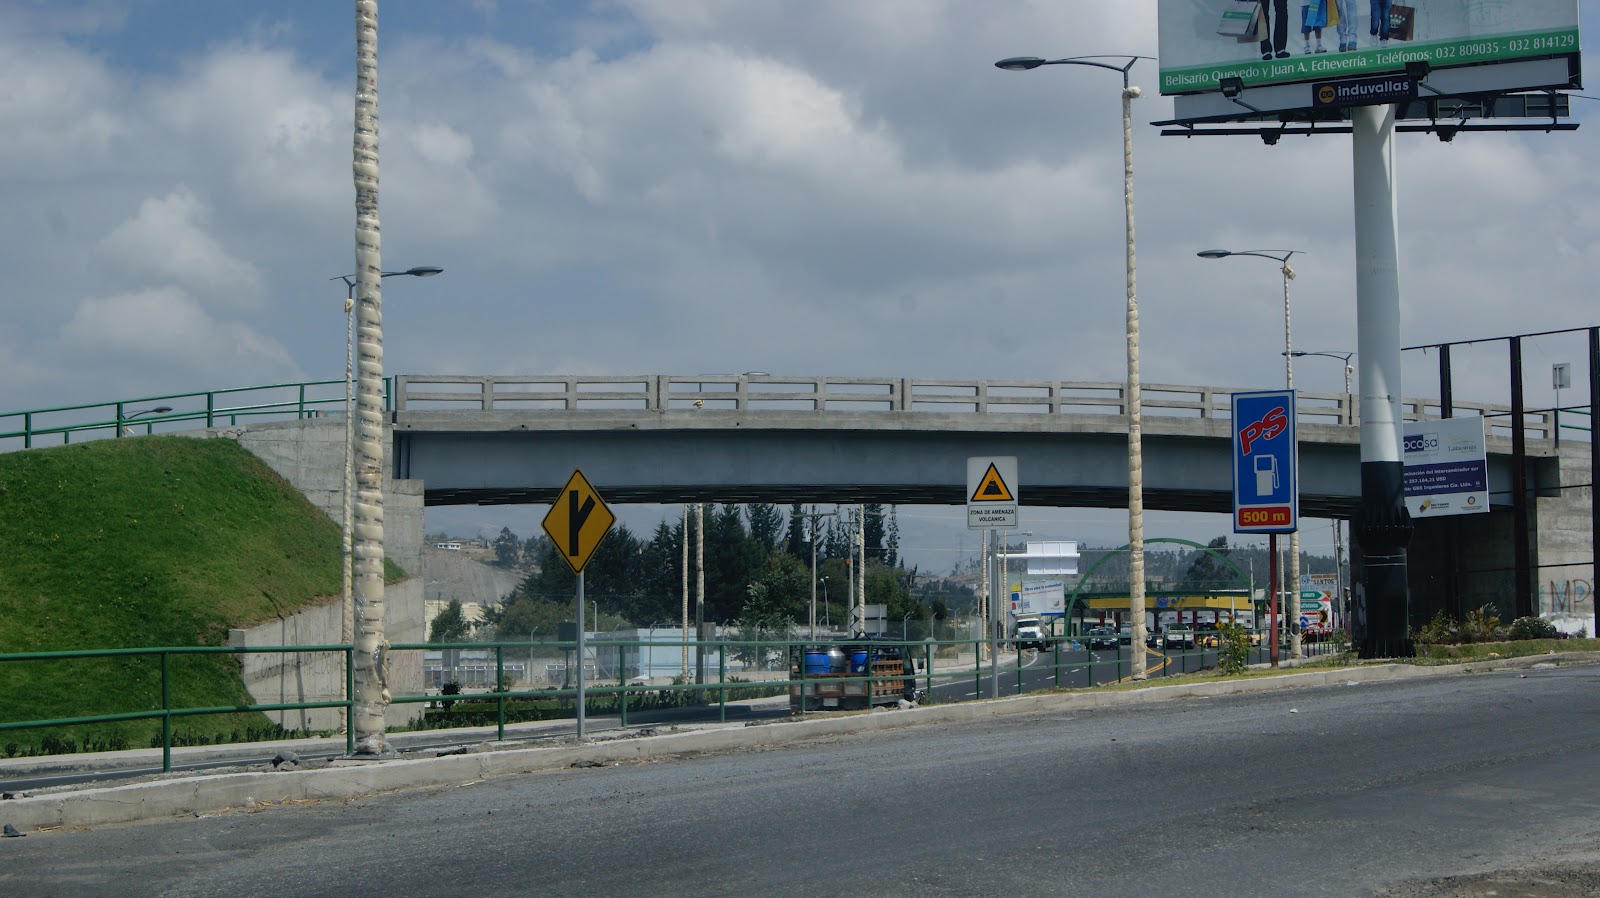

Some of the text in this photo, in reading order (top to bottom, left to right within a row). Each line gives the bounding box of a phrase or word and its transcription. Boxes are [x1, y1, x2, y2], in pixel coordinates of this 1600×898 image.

[1165, 71, 1209, 86] Belisario
[1212, 67, 1259, 82] Quevedo
[1262, 68, 1268, 78] y
[1270, 64, 1294, 77] Juan
[1297, 62, 1308, 72] A.
[1312, 55, 1366, 71] Echeverría
[1376, 51, 1432, 65] Teléfonos:
[1436, 47, 1456, 59] 032
[1459, 42, 1499, 56] 809035
[1509, 38, 1530, 51] 032
[1534, 34, 1574, 49] 814129
[1338, 80, 1410, 97] induvallas
[1243, 511, 1285, 523] 500 m
